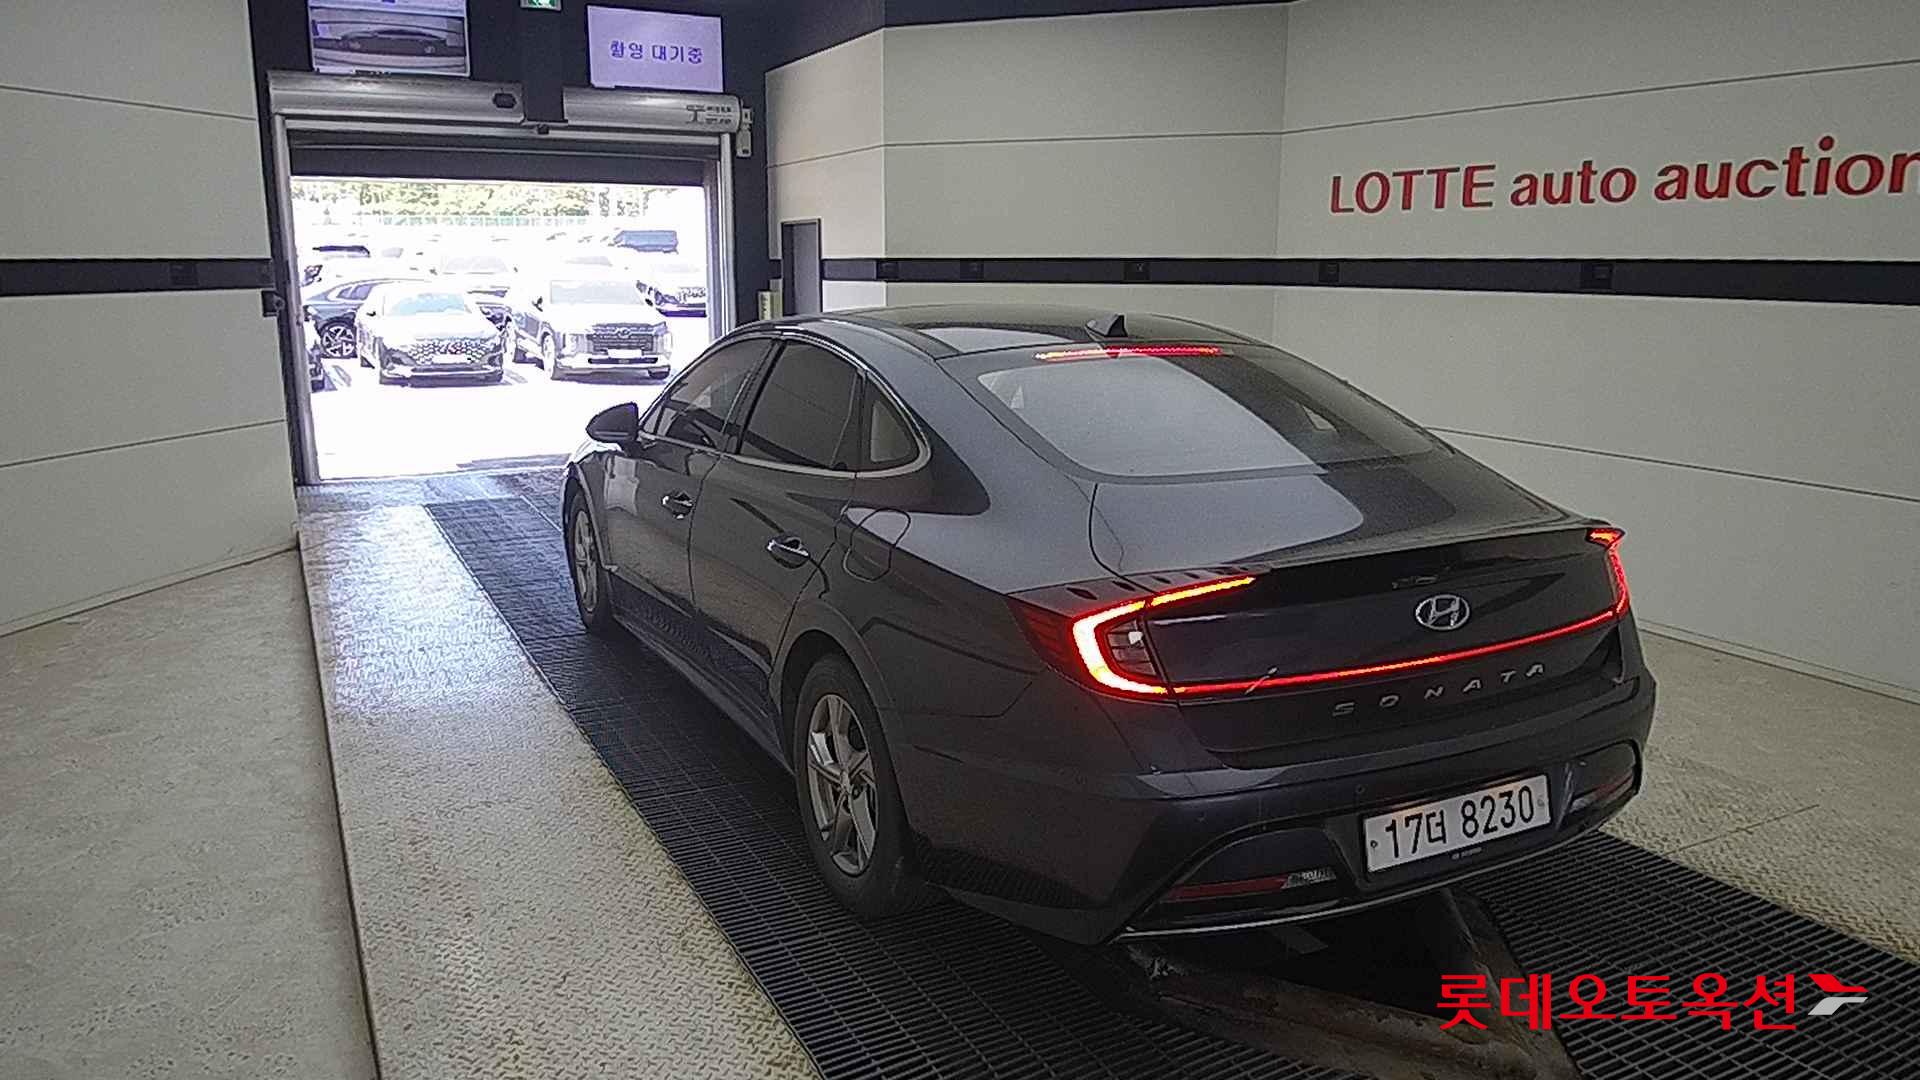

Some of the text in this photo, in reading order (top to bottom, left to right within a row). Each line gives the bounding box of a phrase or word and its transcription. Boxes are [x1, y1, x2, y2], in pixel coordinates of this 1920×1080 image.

[652, 45, 703, 64] 대기중
[1331, 164, 1496, 213] LOTTE
[1511, 160, 1637, 206] auto
[1332, 664, 1546, 717] SONATA
[1385, 785, 1534, 858] 17더 8230
